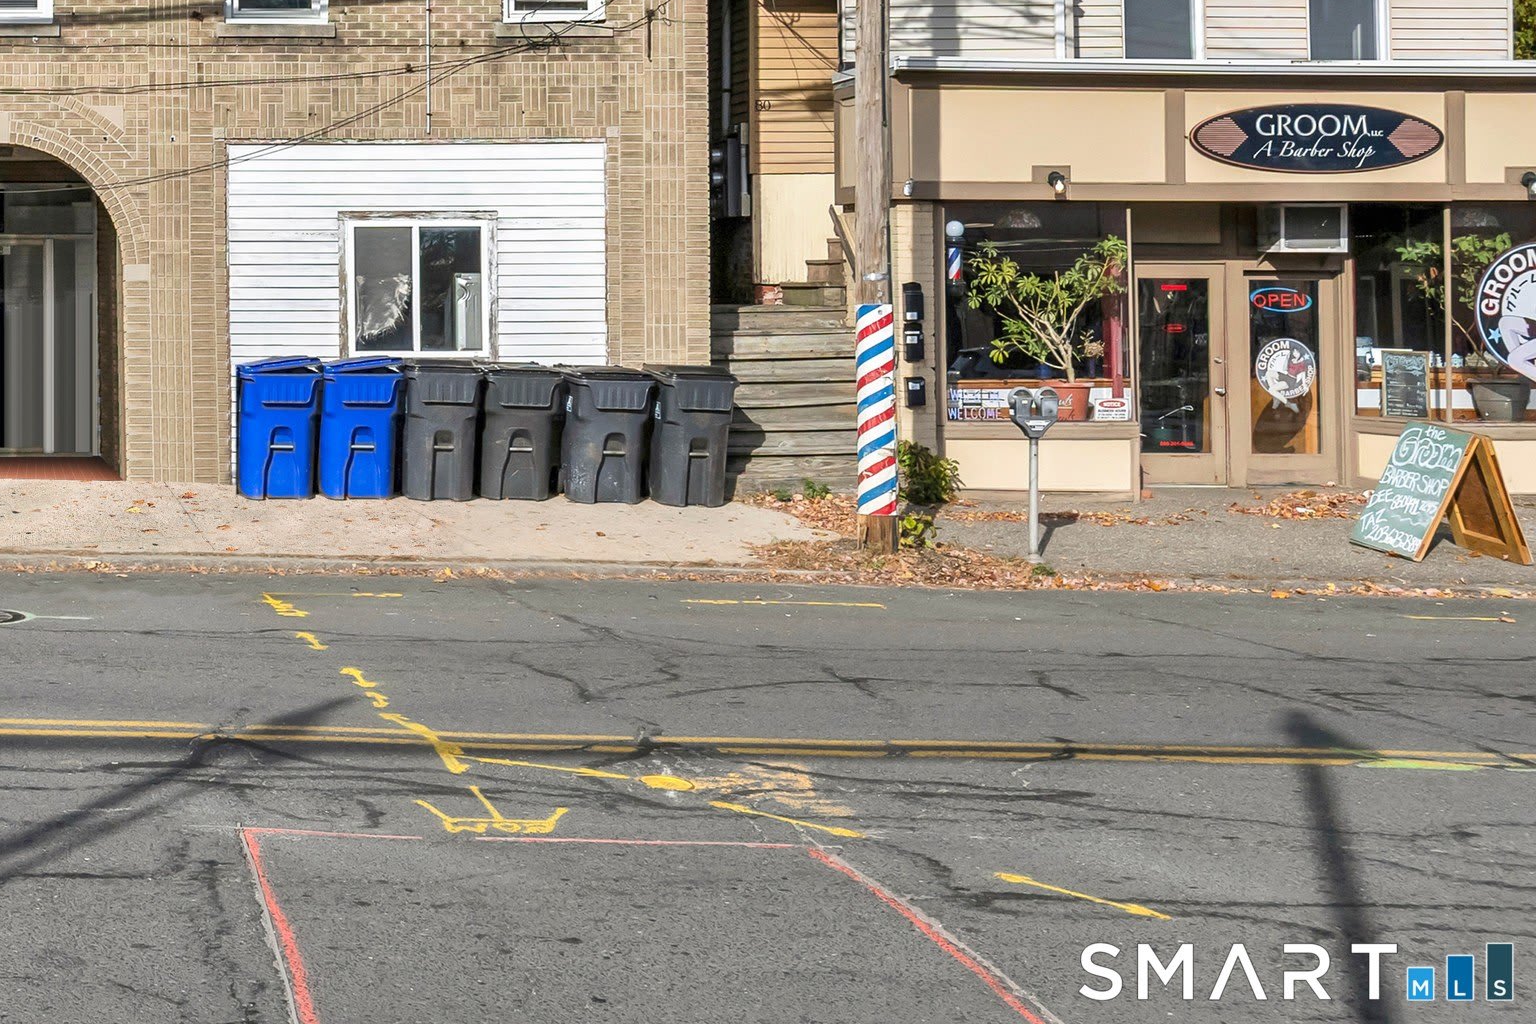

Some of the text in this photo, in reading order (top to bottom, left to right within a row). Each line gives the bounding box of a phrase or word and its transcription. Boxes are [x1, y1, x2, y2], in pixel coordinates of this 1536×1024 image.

[1255, 114, 1370, 137] GROOM
[1253, 133, 1377, 168] A Barber Shop
[1254, 293, 1305, 308] OPEN
[1258, 340, 1290, 371] GROOM
[948, 407, 1001, 420] WELCOME
[1425, 426, 1447, 440] the
[1379, 464, 1450, 497] BARBER SHOP
[1360, 508, 1388, 532] TAZ
